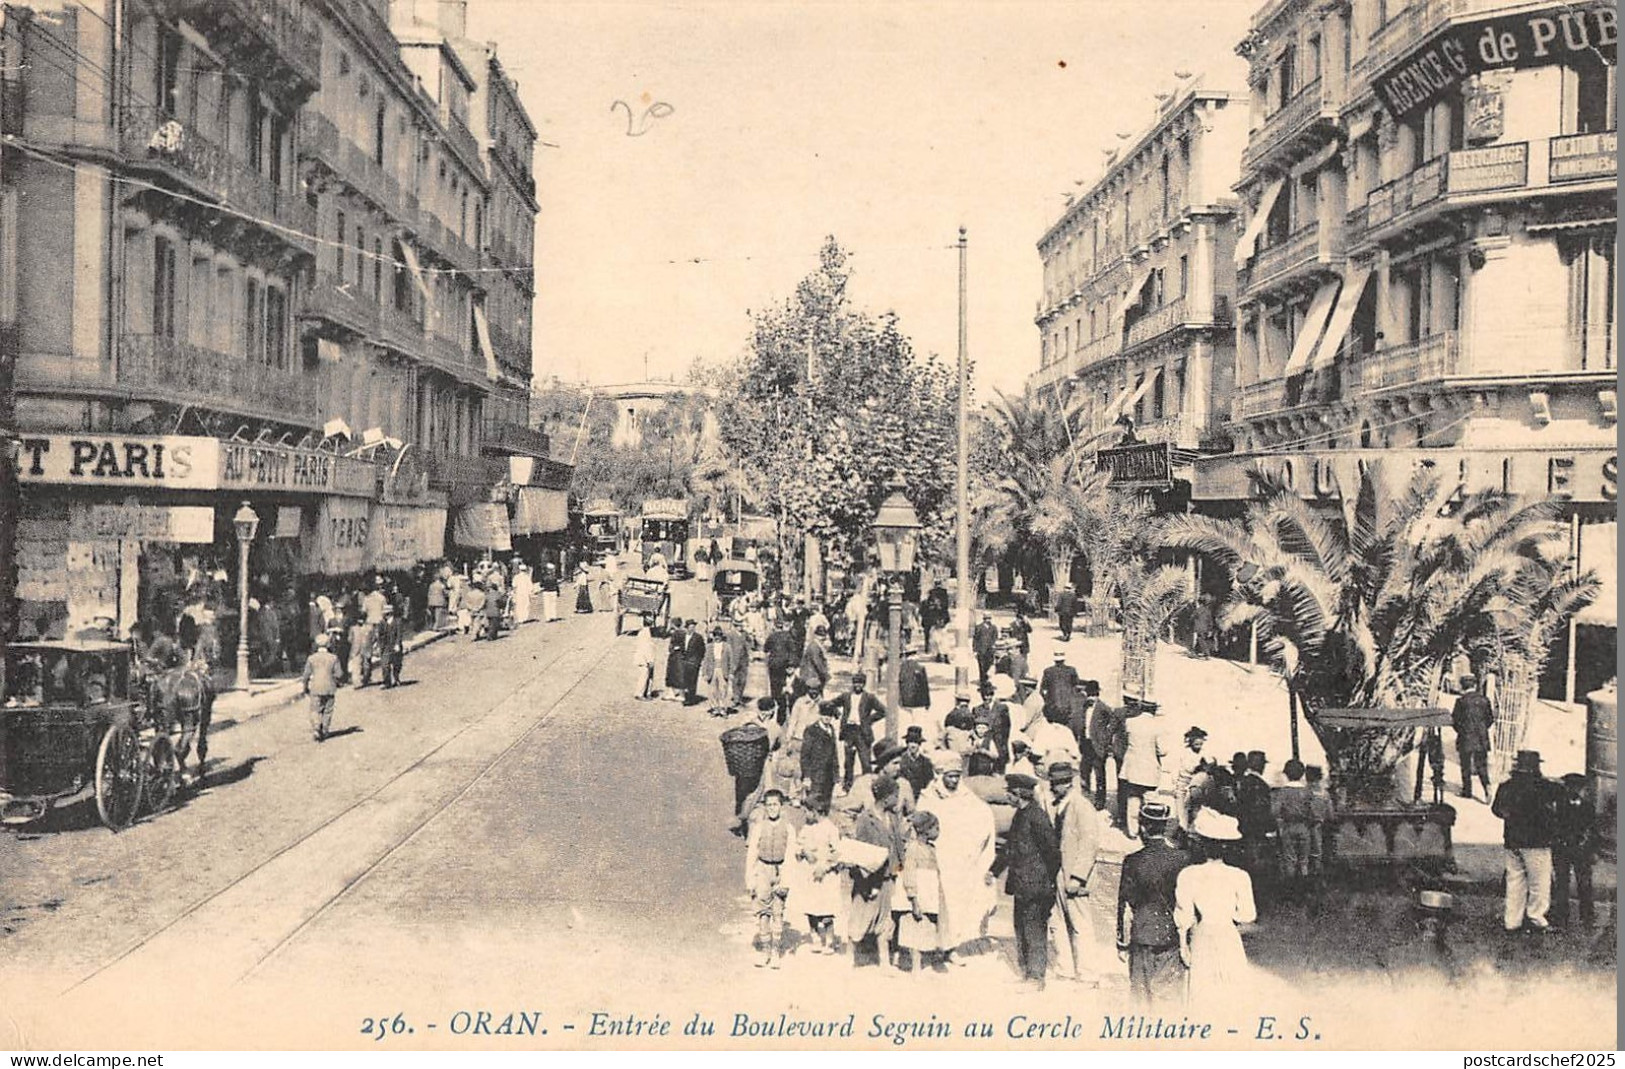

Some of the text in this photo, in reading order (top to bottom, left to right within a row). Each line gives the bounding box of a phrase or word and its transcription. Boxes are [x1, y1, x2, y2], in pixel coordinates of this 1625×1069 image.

[1383, 50, 1454, 115] AGENCE
[1478, 26, 1519, 64] de
[1528, 7, 1617, 57] PUB
[69, 440, 192, 479] PARIS
[224, 446, 328, 486] AU PETIT PARIS
